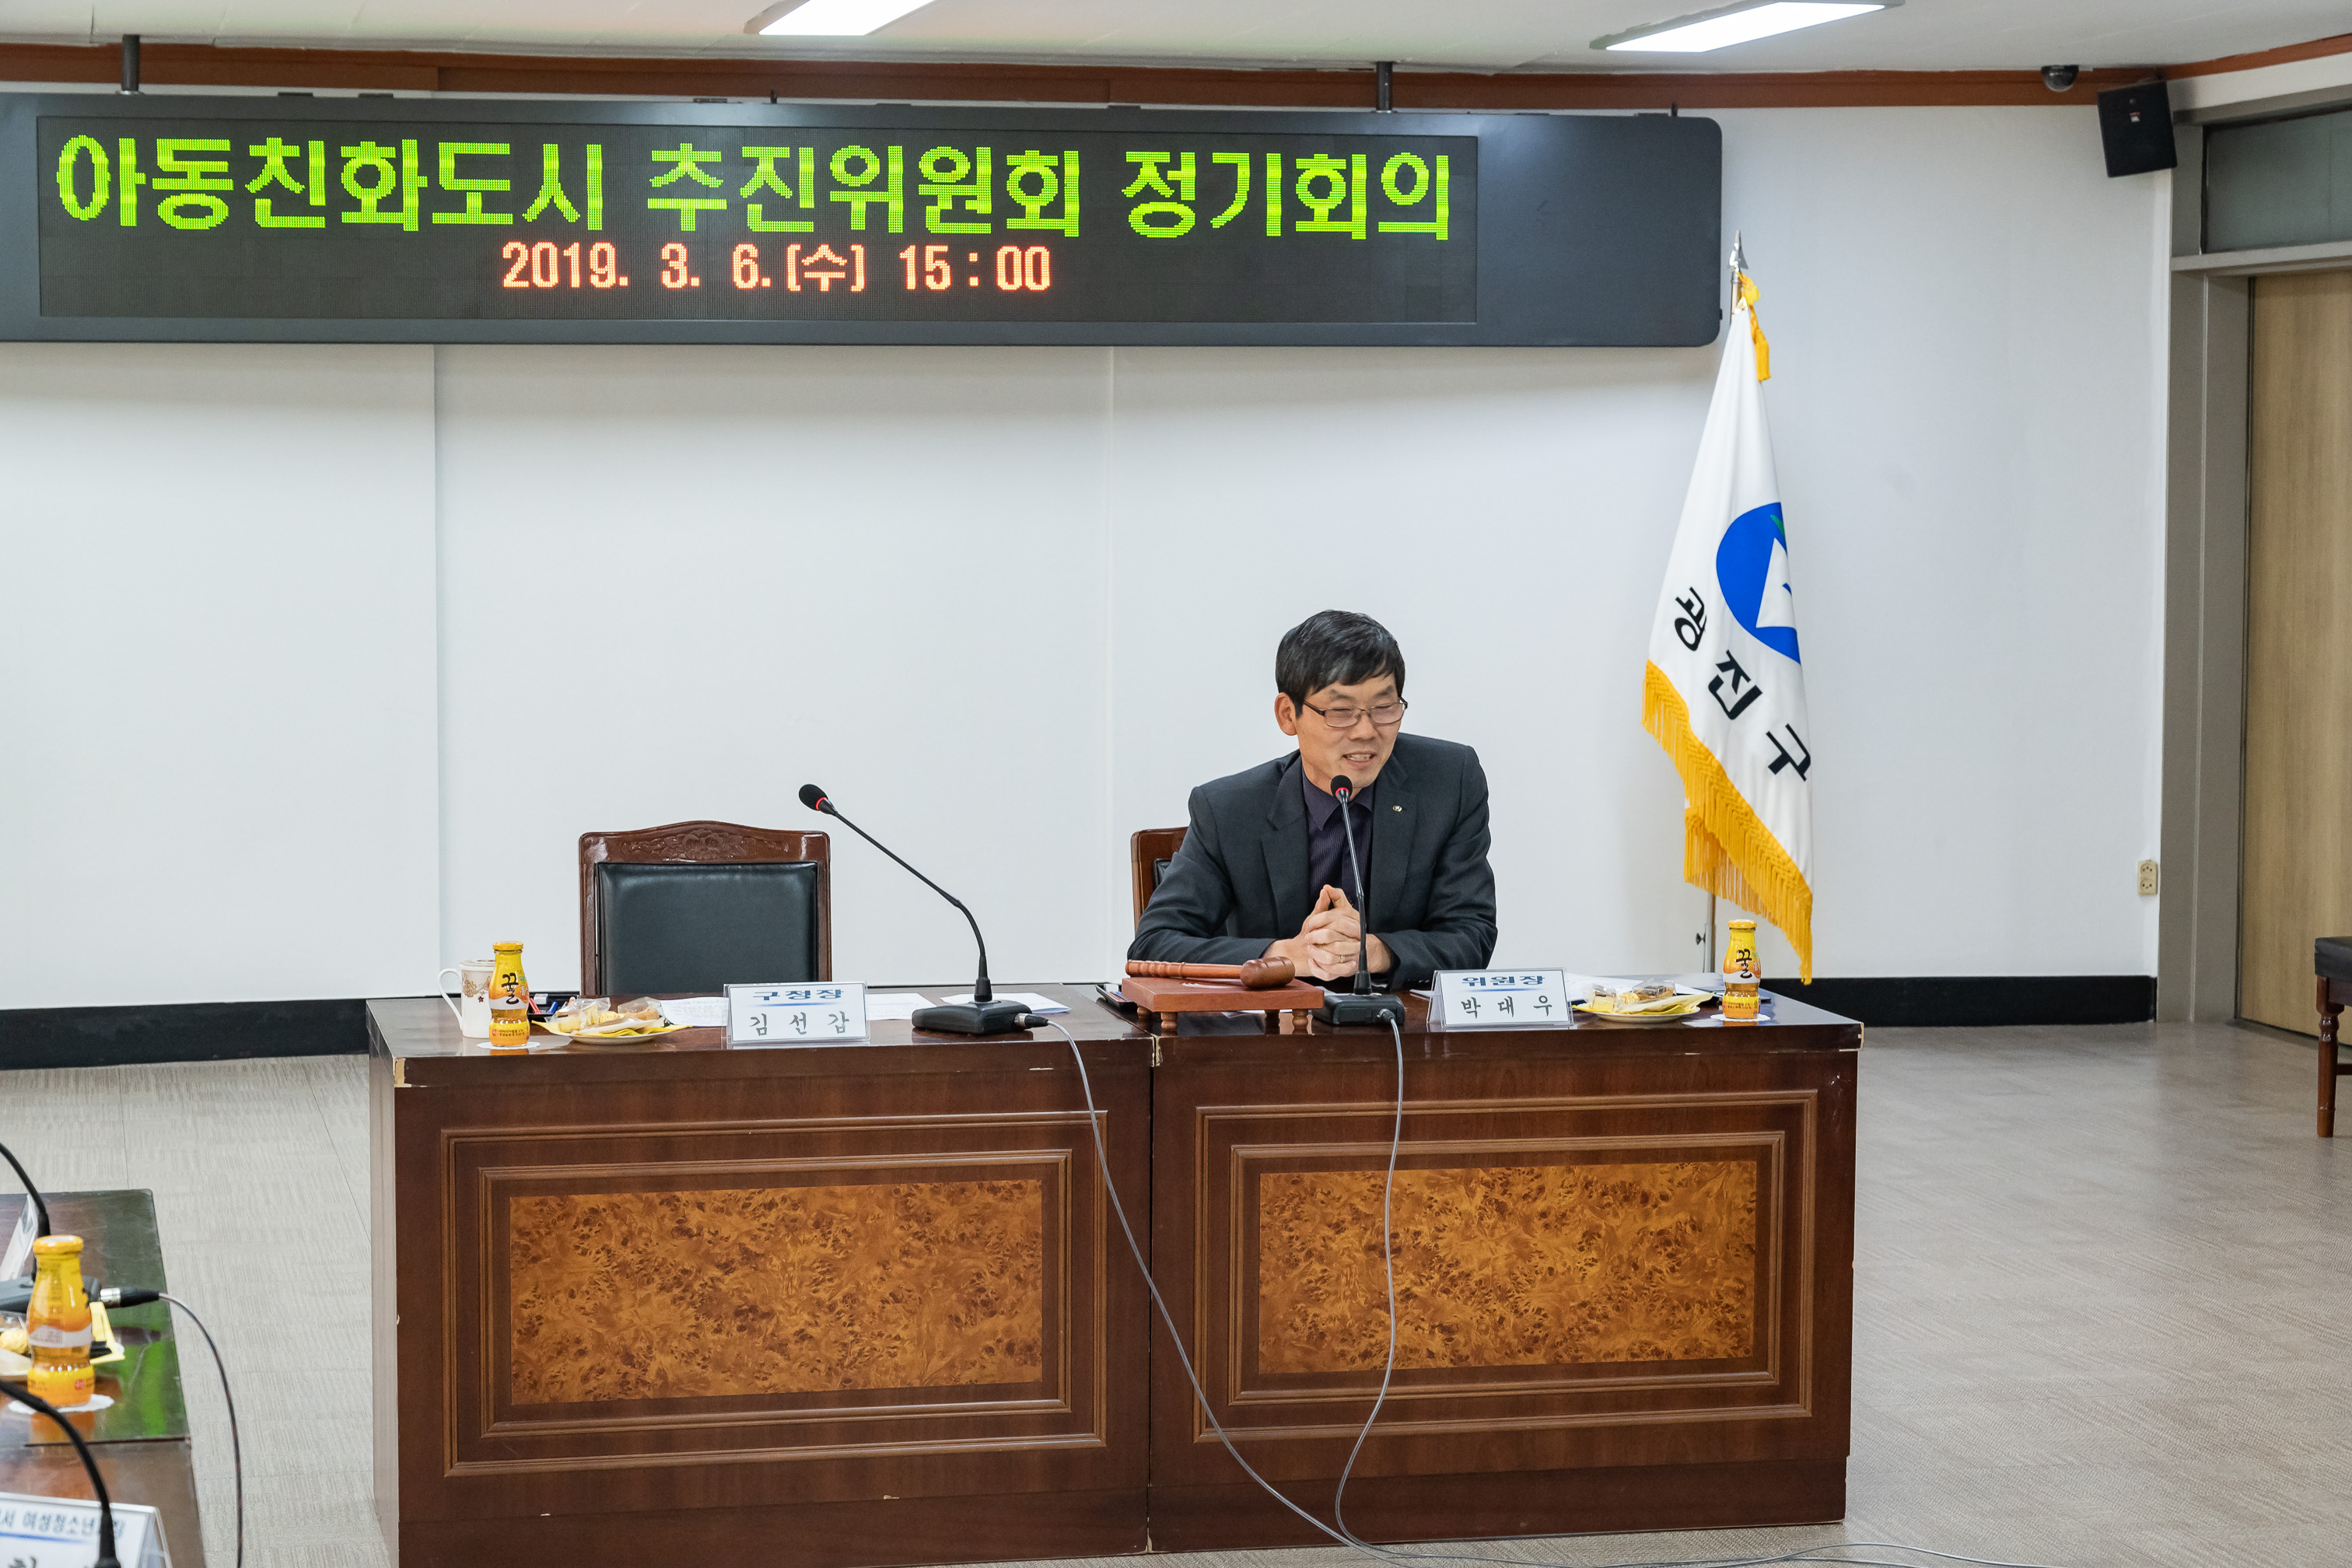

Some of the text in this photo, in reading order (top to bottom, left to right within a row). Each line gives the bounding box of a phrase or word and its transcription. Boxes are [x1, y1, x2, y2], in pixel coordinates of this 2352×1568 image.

[56, 135, 1450, 241] 아동친화도시 추진위원회 정기회의
[502, 241, 628, 290] 2019.
[660, 242, 700, 291] 3.
[1462, 975, 1545, 987] 위원장
